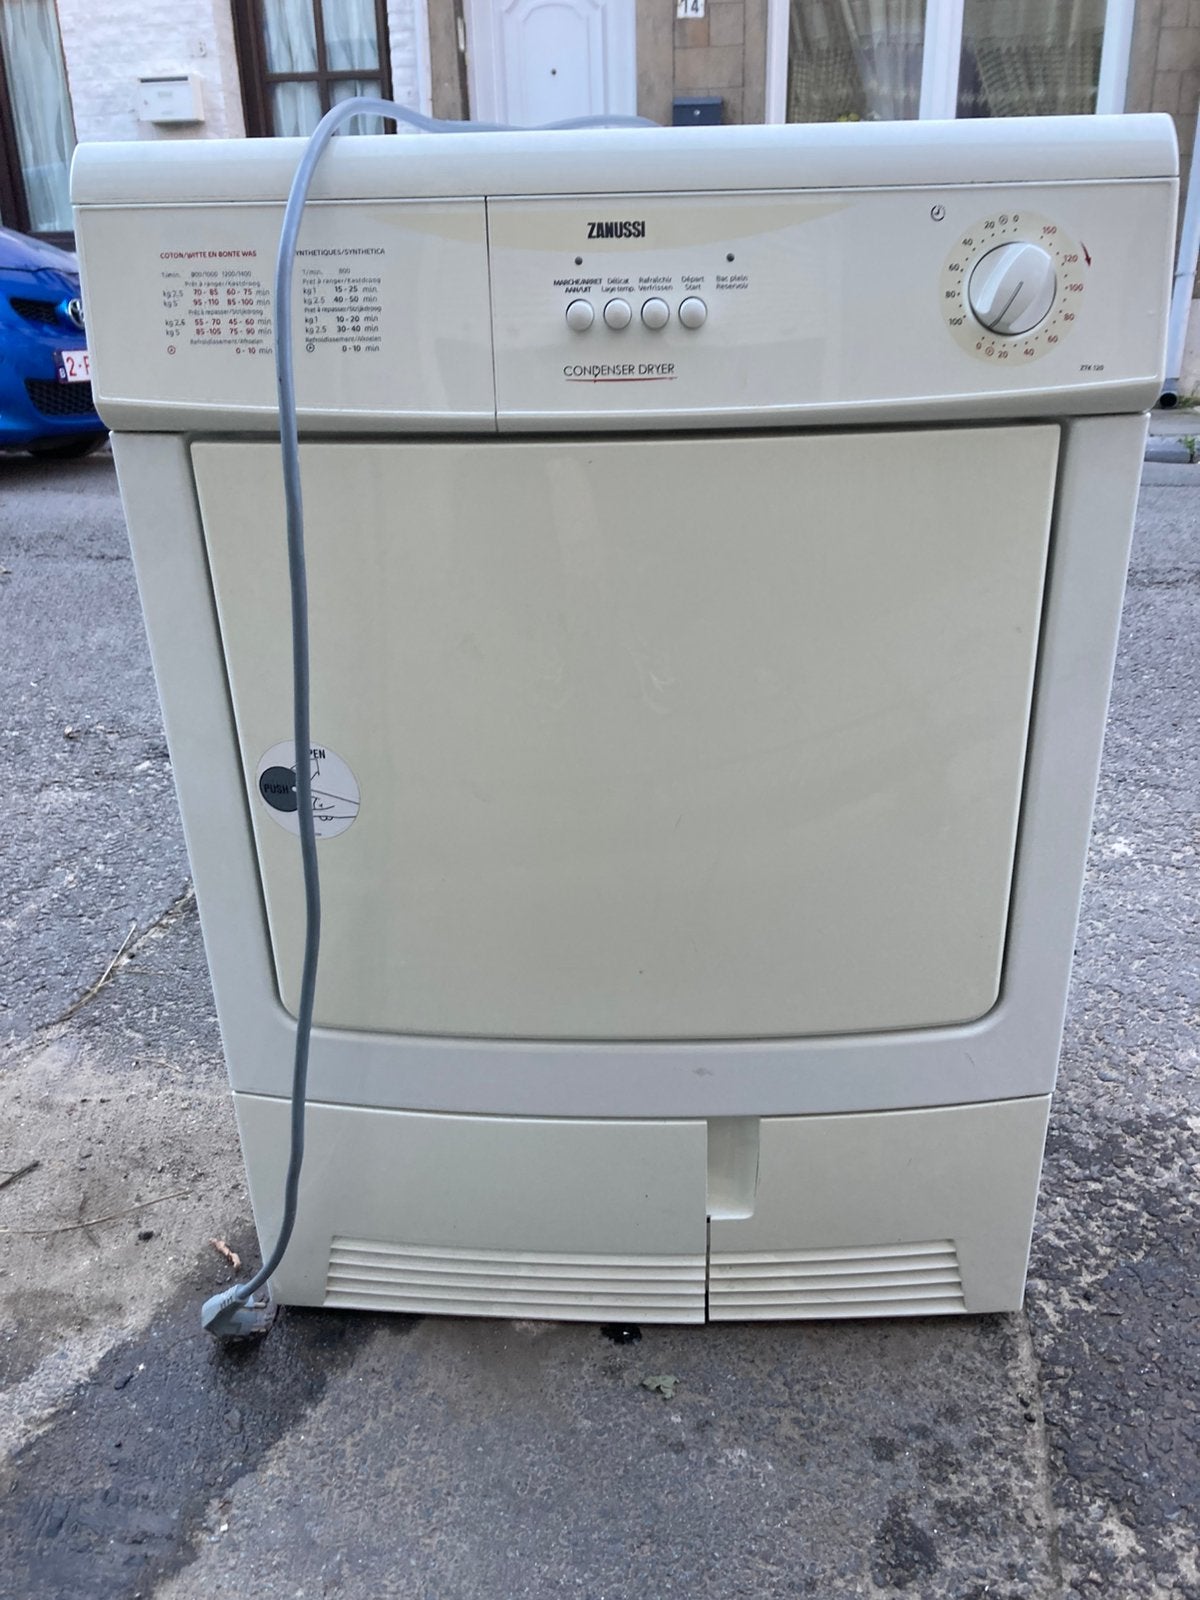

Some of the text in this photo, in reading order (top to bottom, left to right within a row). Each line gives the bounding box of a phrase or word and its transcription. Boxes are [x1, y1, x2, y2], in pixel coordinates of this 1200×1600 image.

[680, 0, 699, 13] 14
[984, 221, 995, 229] 20
[587, 221, 645, 239] ZANUSSI
[160, 251, 206, 259] COTON/WITTE
[296, 248, 385, 256] YNTHETIQUES/SYNTHETICA
[1064, 254, 1078, 262] 120
[949, 263, 960, 271] 60
[227, 288, 236, 296] 60
[303, 287, 311, 296] kg
[349, 285, 358, 293] 25
[1069, 284, 1083, 292] 100
[945, 290, 956, 298] 80
[305, 317, 313, 325] kg
[1064, 313, 1075, 321] 80
[194, 318, 204, 326] 55
[212, 318, 221, 326] 70
[949, 318, 963, 326] 100
[246, 327, 255, 335] 90
[1048, 335, 1058, 343] 60
[259, 346, 273, 354] min
[1024, 348, 1035, 356] 40
[998, 350, 1008, 359] 20
[563, 363, 675, 377] CONDENSER DRYER
[309, 749, 326, 759] EN
[263, 783, 290, 795] PUSH
